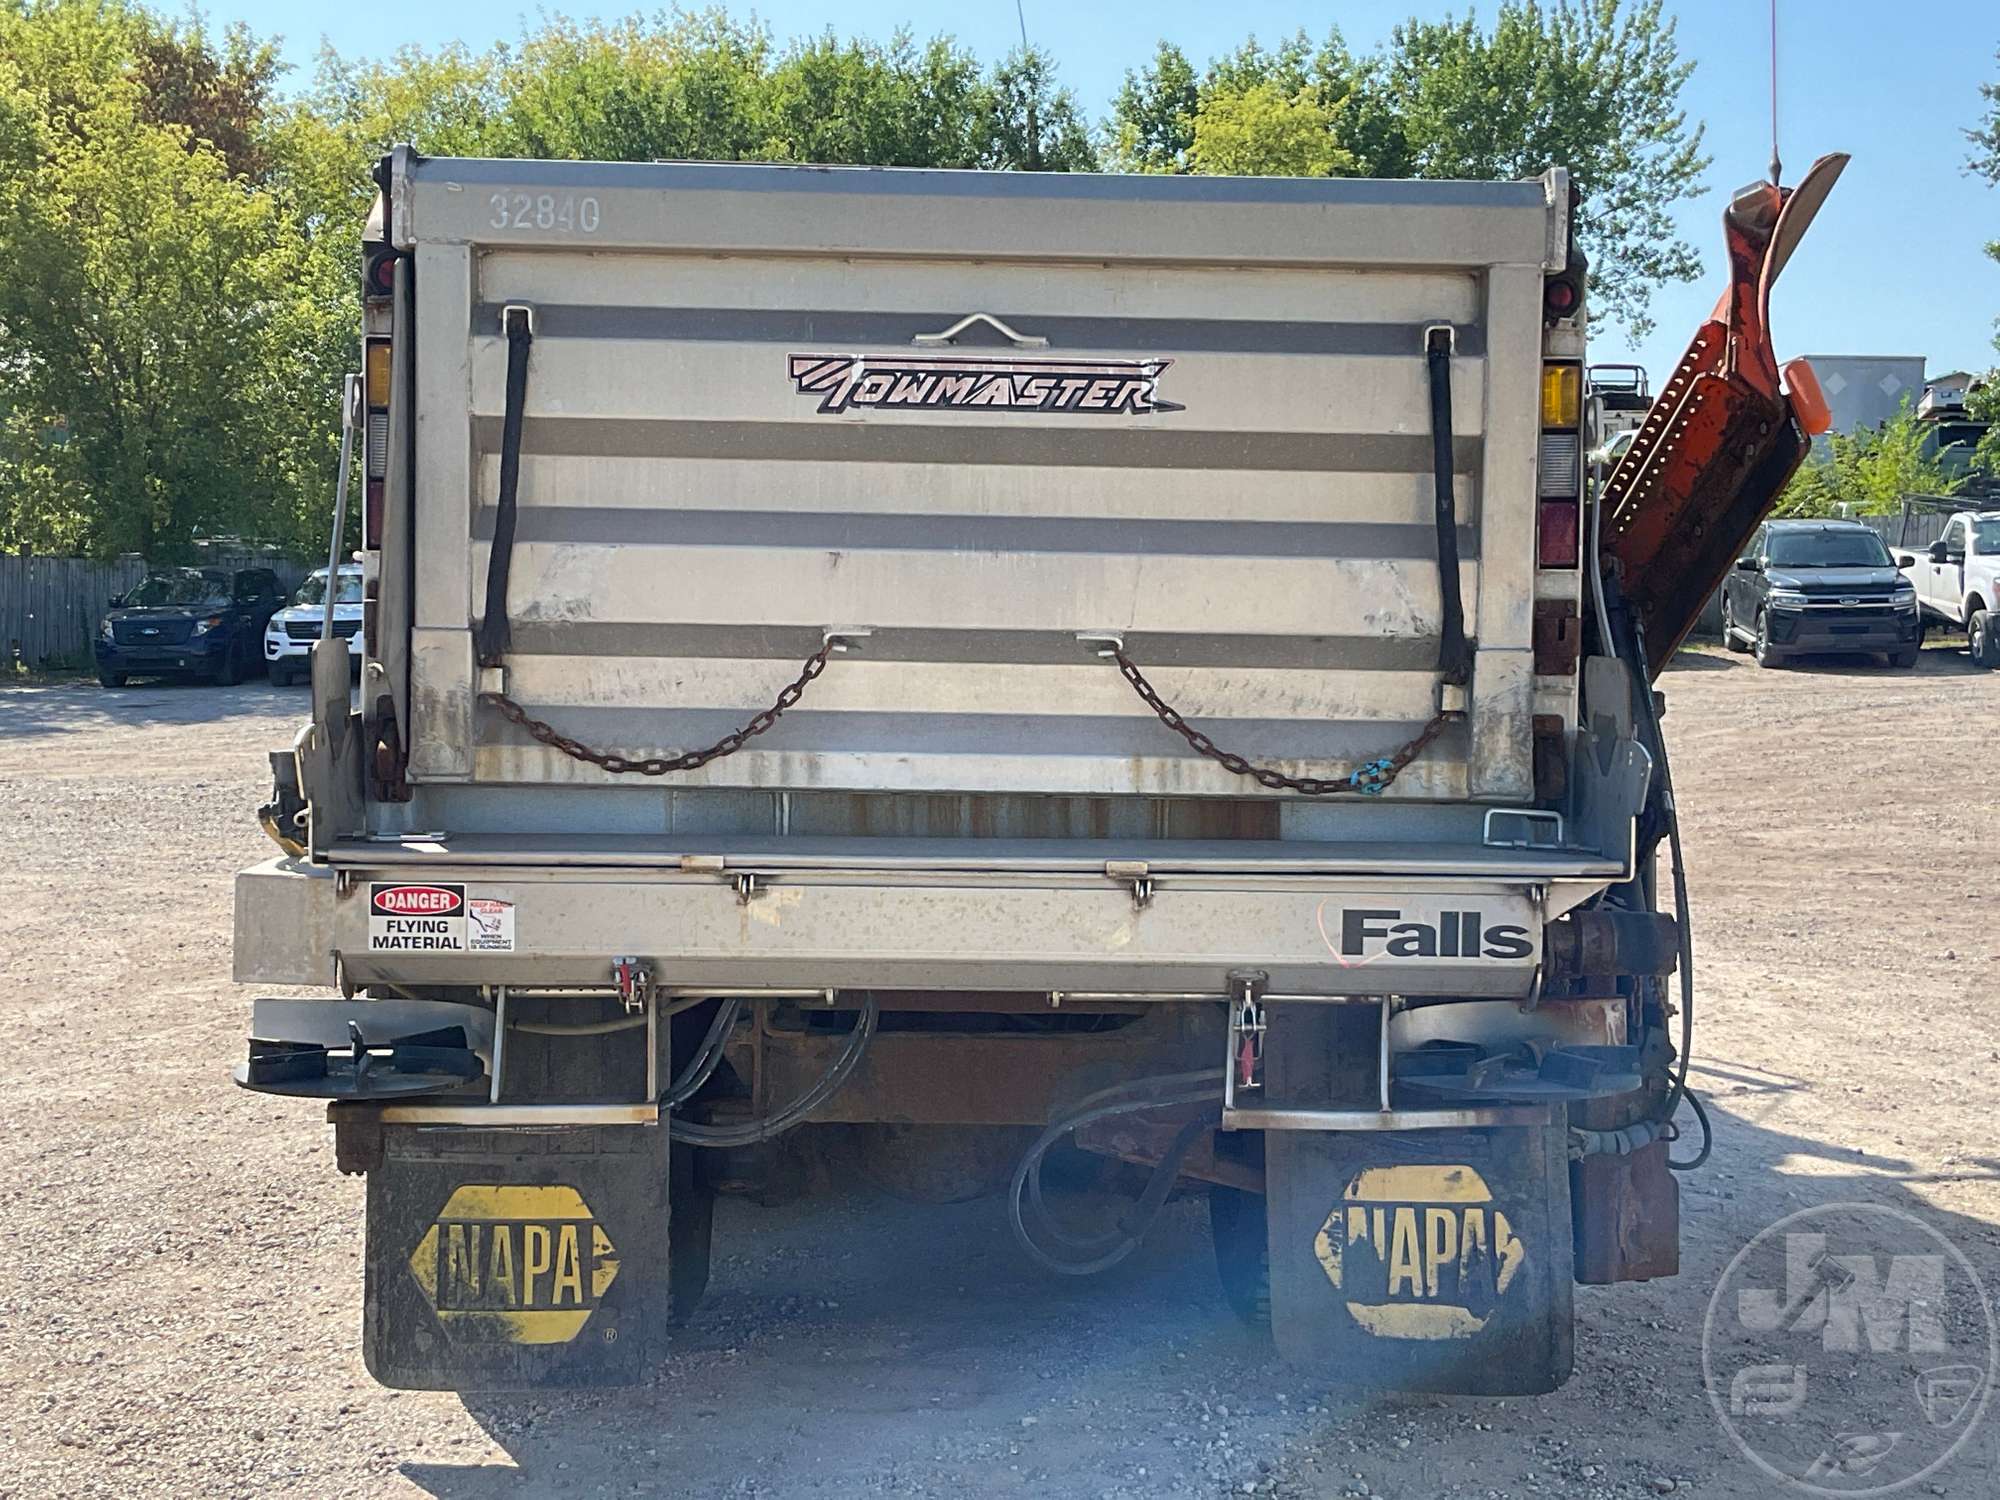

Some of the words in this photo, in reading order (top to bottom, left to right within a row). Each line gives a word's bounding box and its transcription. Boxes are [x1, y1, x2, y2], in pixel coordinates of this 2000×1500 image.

[489, 193, 600, 233] 32840
[384, 892, 451, 910] DANGER
[386, 920, 449, 934] FLYING
[1341, 909, 1534, 959] Falls
[372, 935, 463, 950] MATERIAL
[448, 1223, 584, 1305] NAPA
